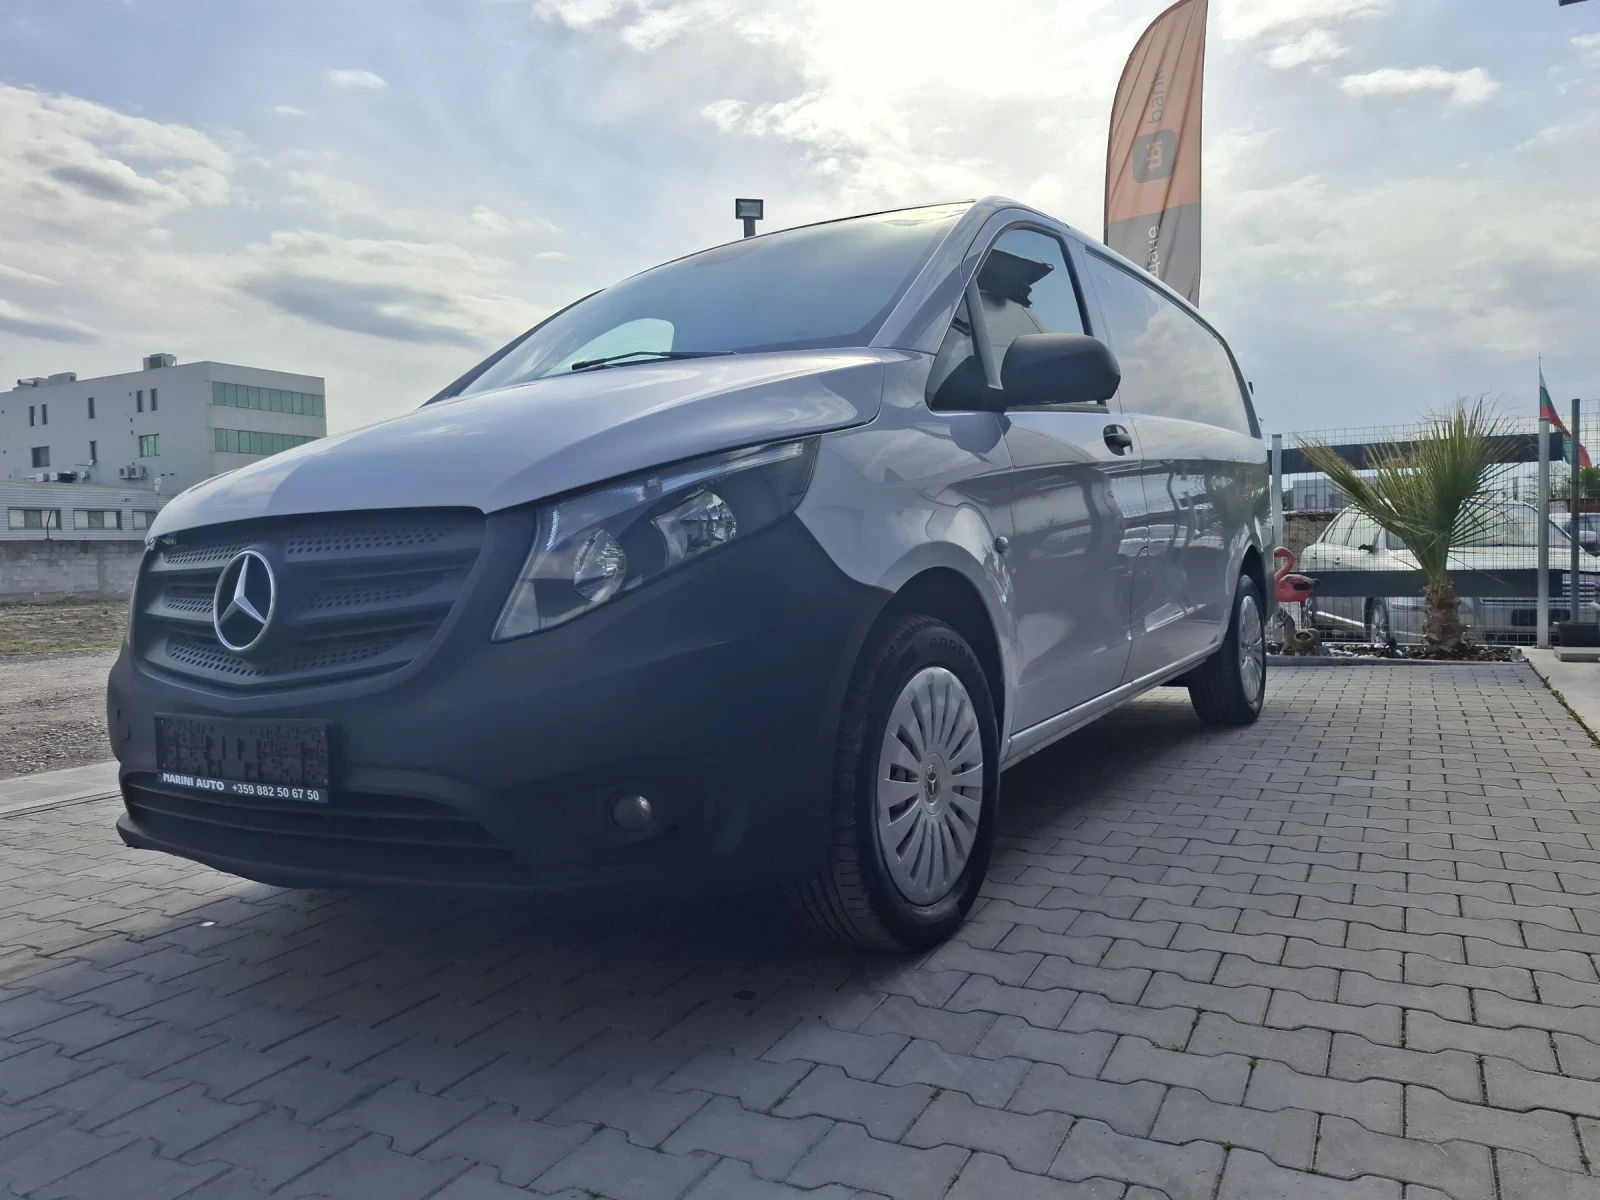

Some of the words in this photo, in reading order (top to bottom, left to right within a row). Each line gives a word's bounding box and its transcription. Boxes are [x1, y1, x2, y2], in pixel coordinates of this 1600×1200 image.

[1147, 68, 1165, 124] bank
[1145, 140, 1163, 172] tbi
[162, 772, 194, 787] MARINI
[196, 778, 225, 791] AUTO
[231, 783, 255, 795] +359
[256, 785, 275, 797] 882
[277, 787, 289, 798] 50
[291, 788, 304, 799] 67
[307, 789, 320, 801] 50
